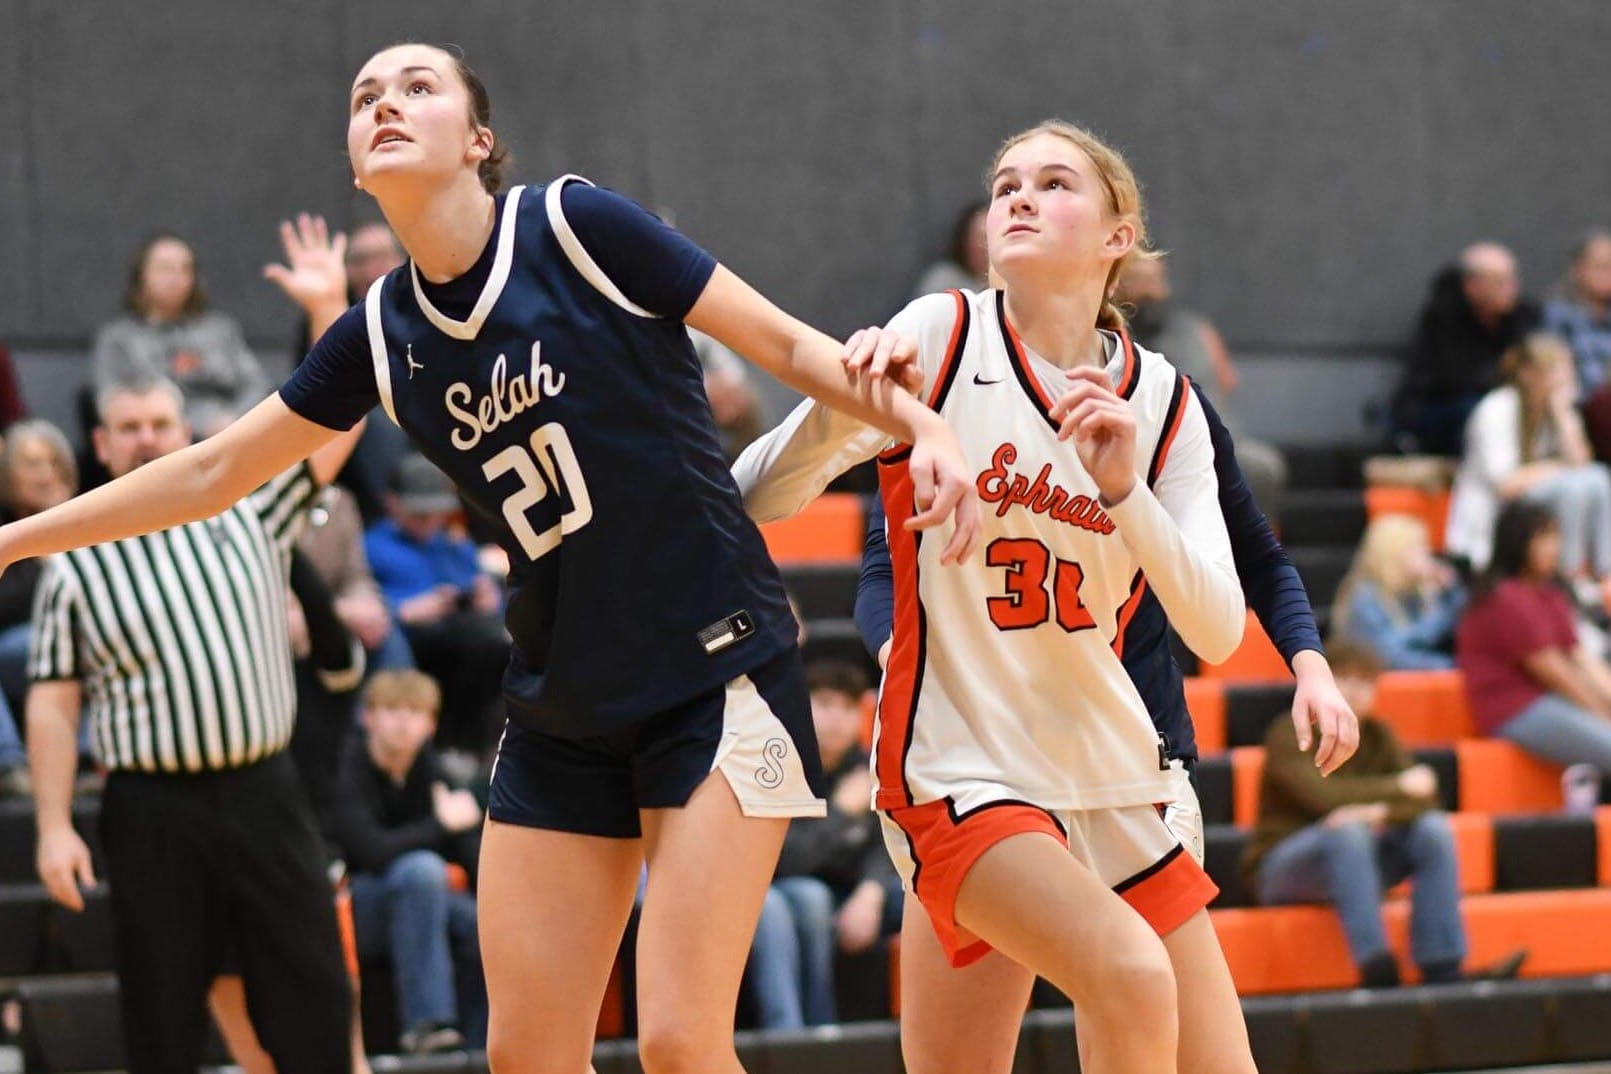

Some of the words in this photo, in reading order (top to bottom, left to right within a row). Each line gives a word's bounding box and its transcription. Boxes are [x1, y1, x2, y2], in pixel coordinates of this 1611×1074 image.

[445, 340, 566, 450] Selah
[481, 421, 593, 562] 20
[736, 619, 748, 631] L
[754, 737, 787, 790] S
